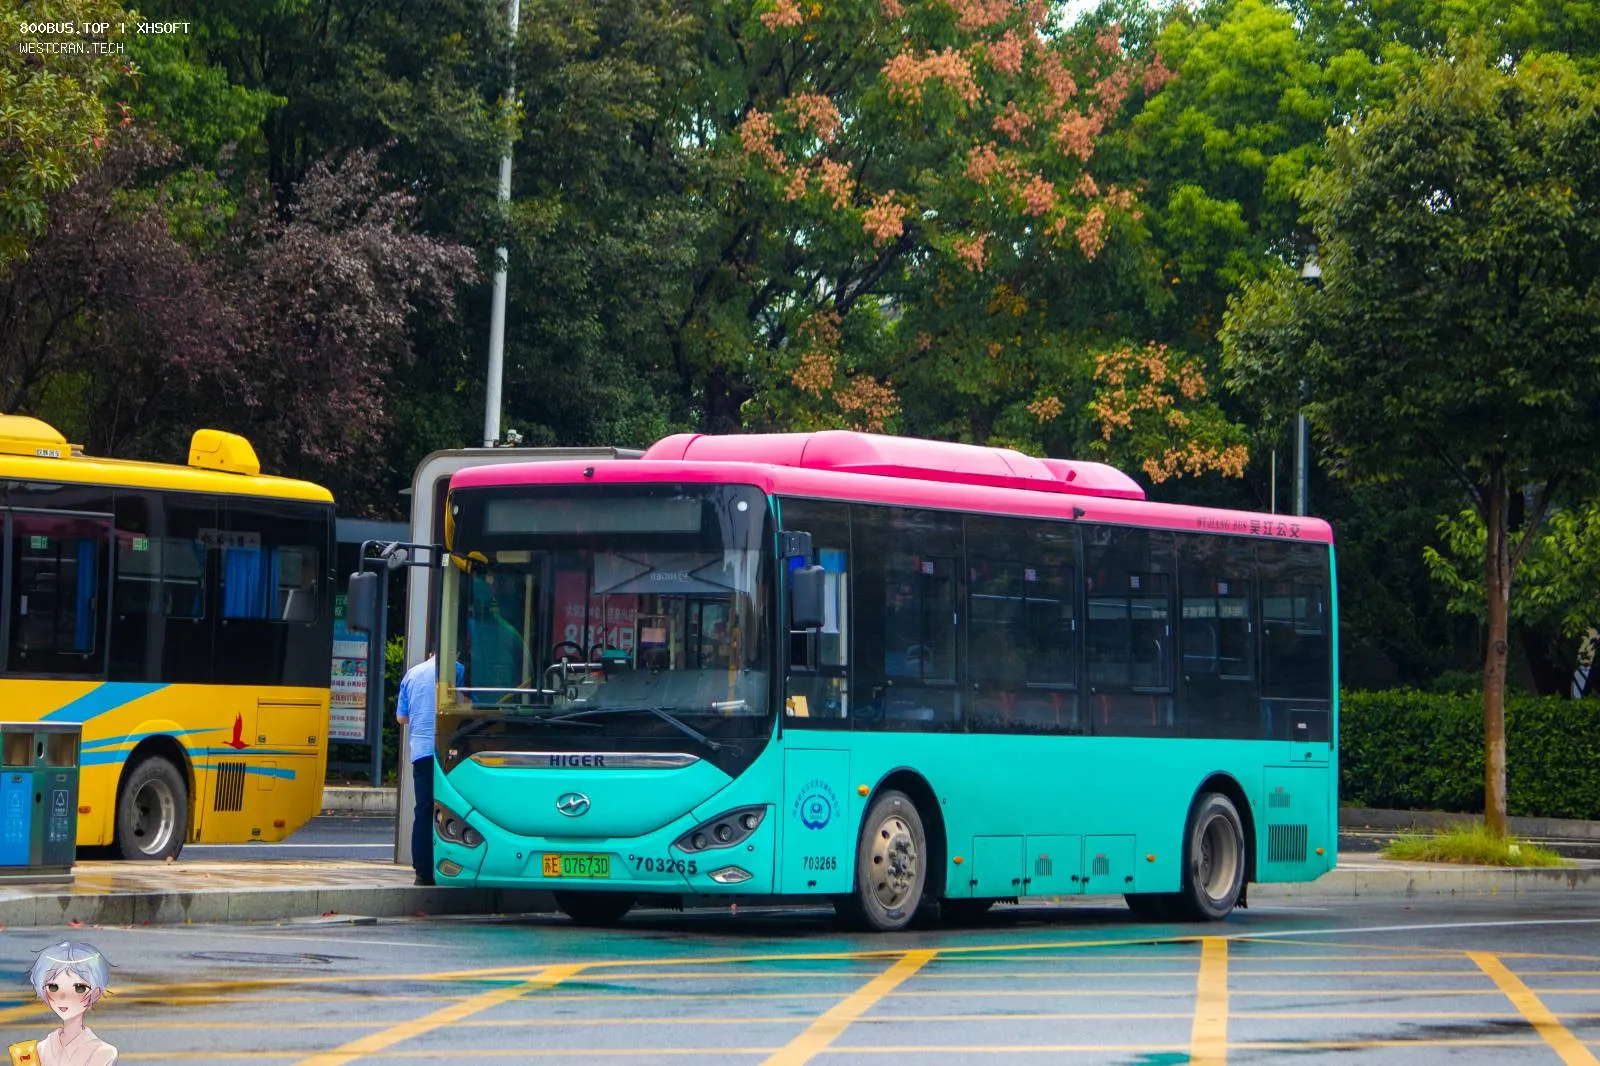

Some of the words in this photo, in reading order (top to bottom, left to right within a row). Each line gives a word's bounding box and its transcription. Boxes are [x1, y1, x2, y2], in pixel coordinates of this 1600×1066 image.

[1250, 519, 1301, 537] 吴江公交
[549, 754, 605, 767] HIGER
[635, 856, 698, 875] 703265
[803, 856, 837, 871] 703265
